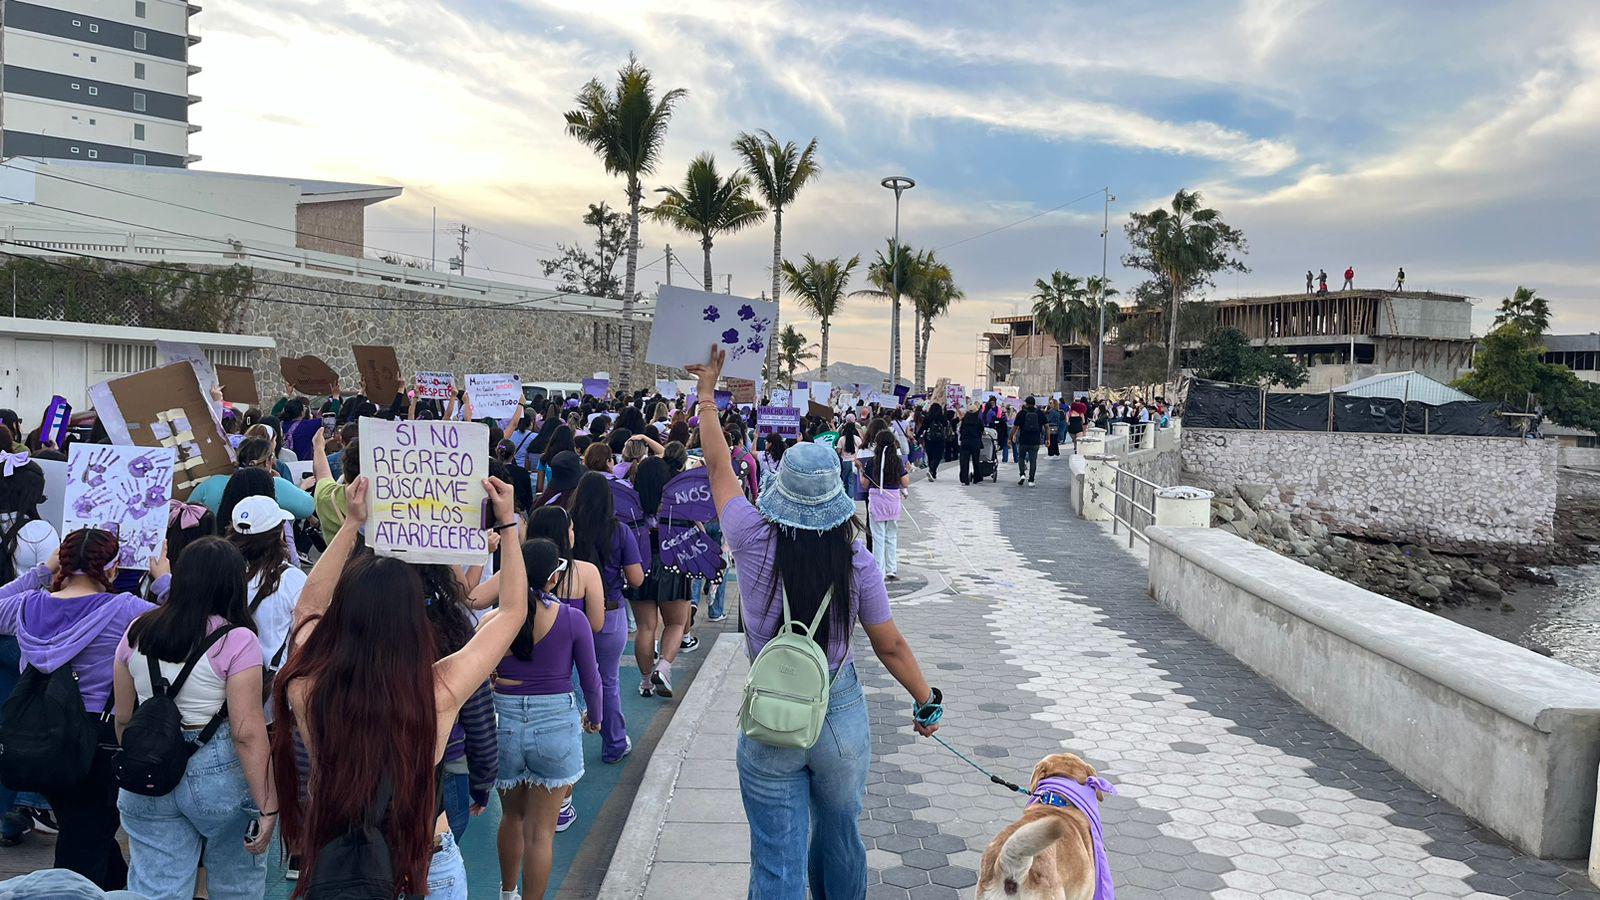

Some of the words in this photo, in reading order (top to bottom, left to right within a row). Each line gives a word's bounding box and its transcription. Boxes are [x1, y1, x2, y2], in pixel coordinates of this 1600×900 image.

[501, 399, 519, 407] TODO
[758, 407, 783, 416] MARCHO
[786, 408, 799, 416] HOY
[396, 423, 417, 447] SI
[430, 424, 459, 449] NO
[373, 446, 473, 478] REGRESO
[376, 474, 469, 505] BÚSCAME
[674, 484, 711, 505] NOS
[391, 501, 420, 521] EN
[431, 503, 463, 524] LOS
[375, 520, 486, 550] ATARDECERES
